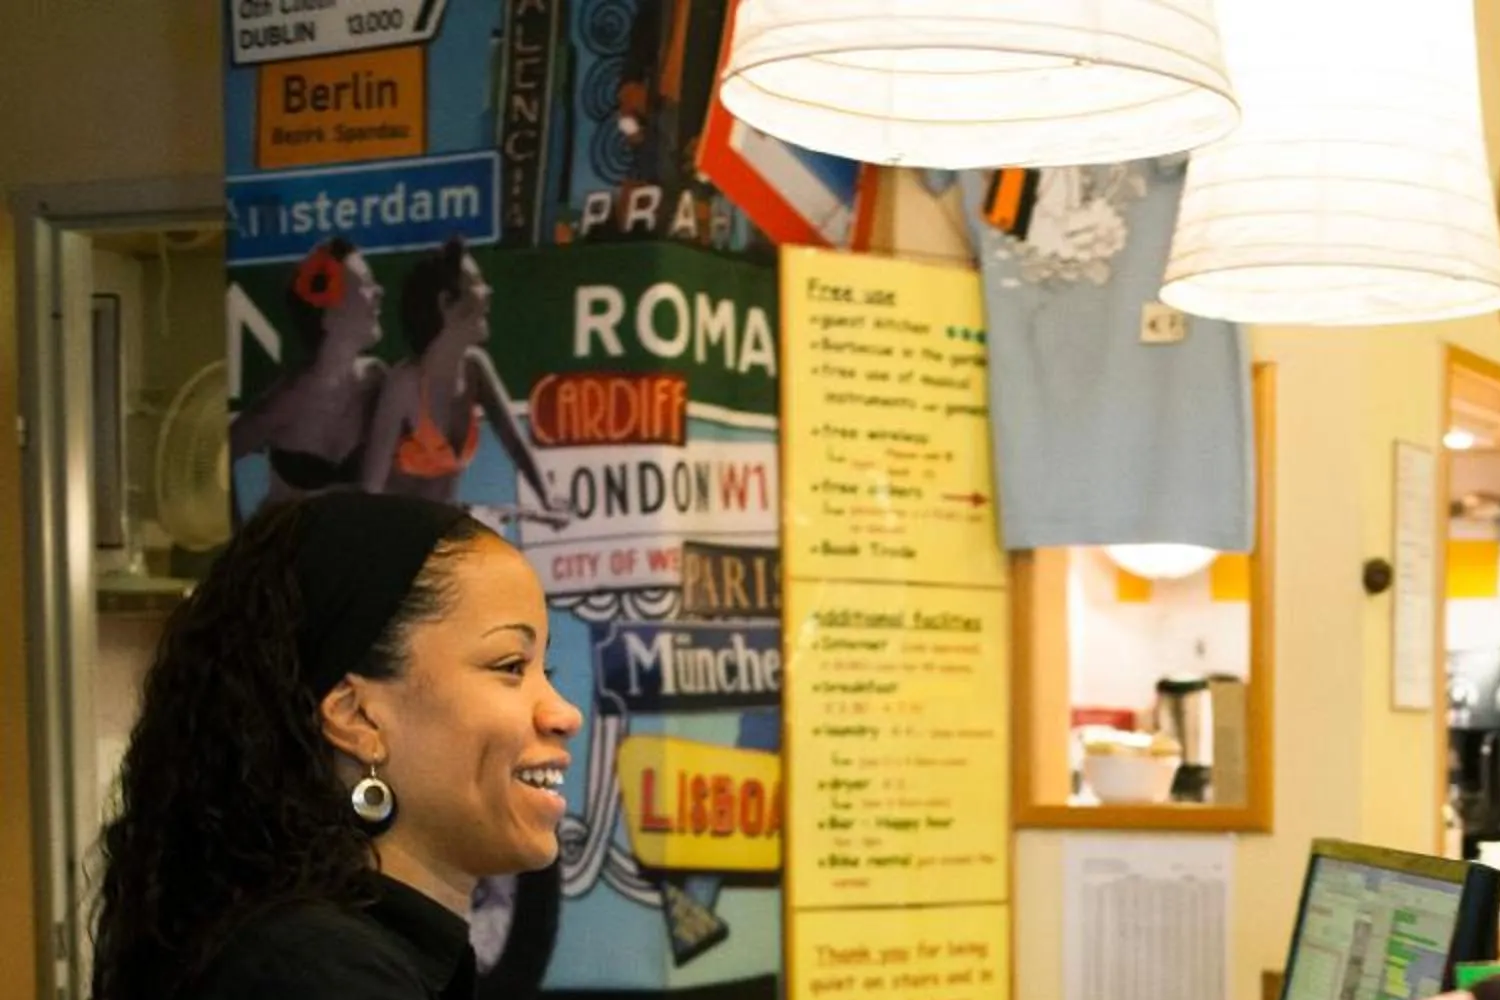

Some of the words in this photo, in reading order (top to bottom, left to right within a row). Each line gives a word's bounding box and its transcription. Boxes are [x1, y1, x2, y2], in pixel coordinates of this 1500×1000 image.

[239, 21, 315, 49] DUBLIN
[284, 71, 398, 113] Berlin
[574, 282, 777, 378] ROMA
[529, 374, 687, 444] CARDIFF
[548, 461, 710, 519] ONDON
[720, 463, 770, 511] W1
[552, 552, 599, 581] CITY
[609, 548, 637, 576] OF
[623, 631, 780, 695] Münche
